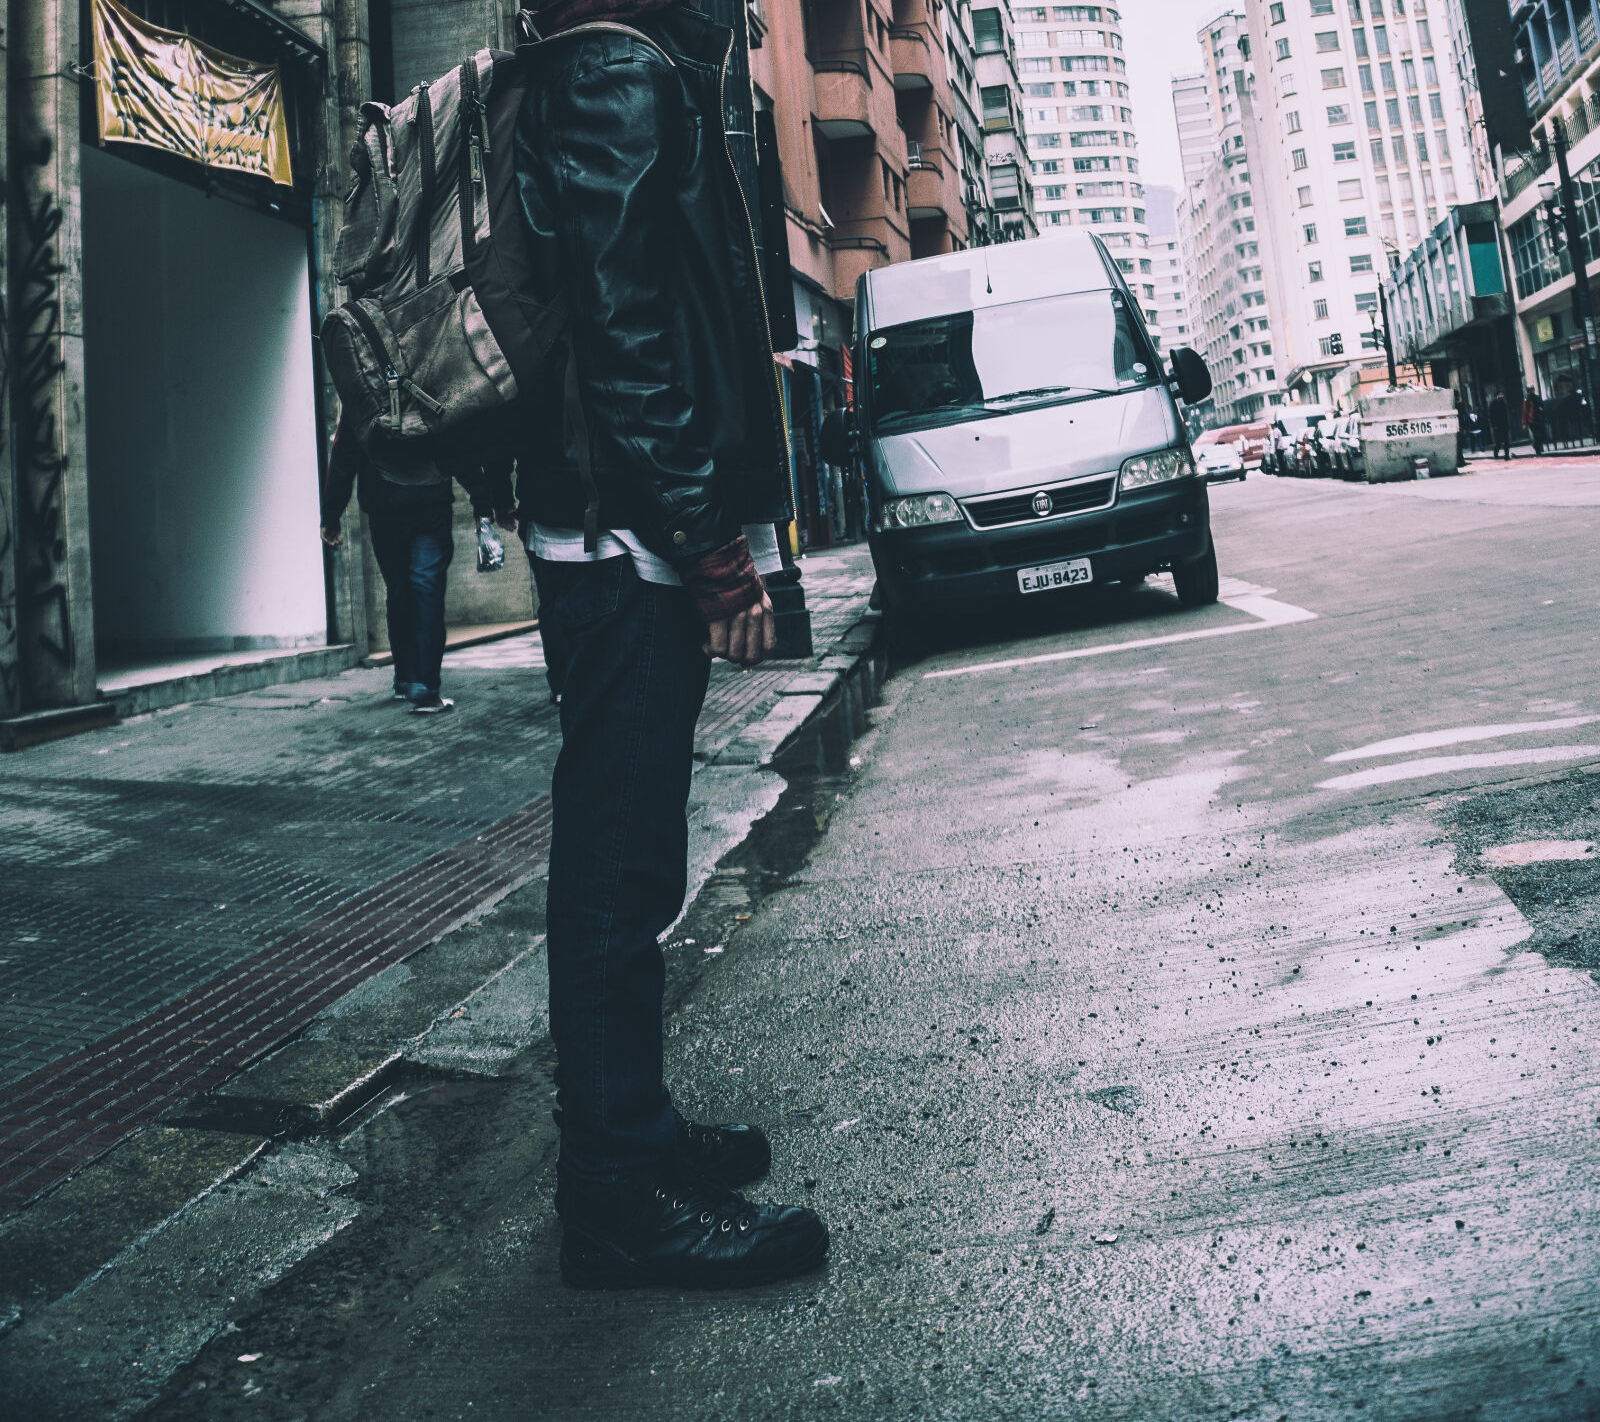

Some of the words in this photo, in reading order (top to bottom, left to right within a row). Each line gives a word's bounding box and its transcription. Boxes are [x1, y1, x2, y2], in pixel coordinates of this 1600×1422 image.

[1386, 424, 1408, 437] 5565
[1410, 421, 1432, 434] 5105
[1036, 498, 1048, 510] FIAT
